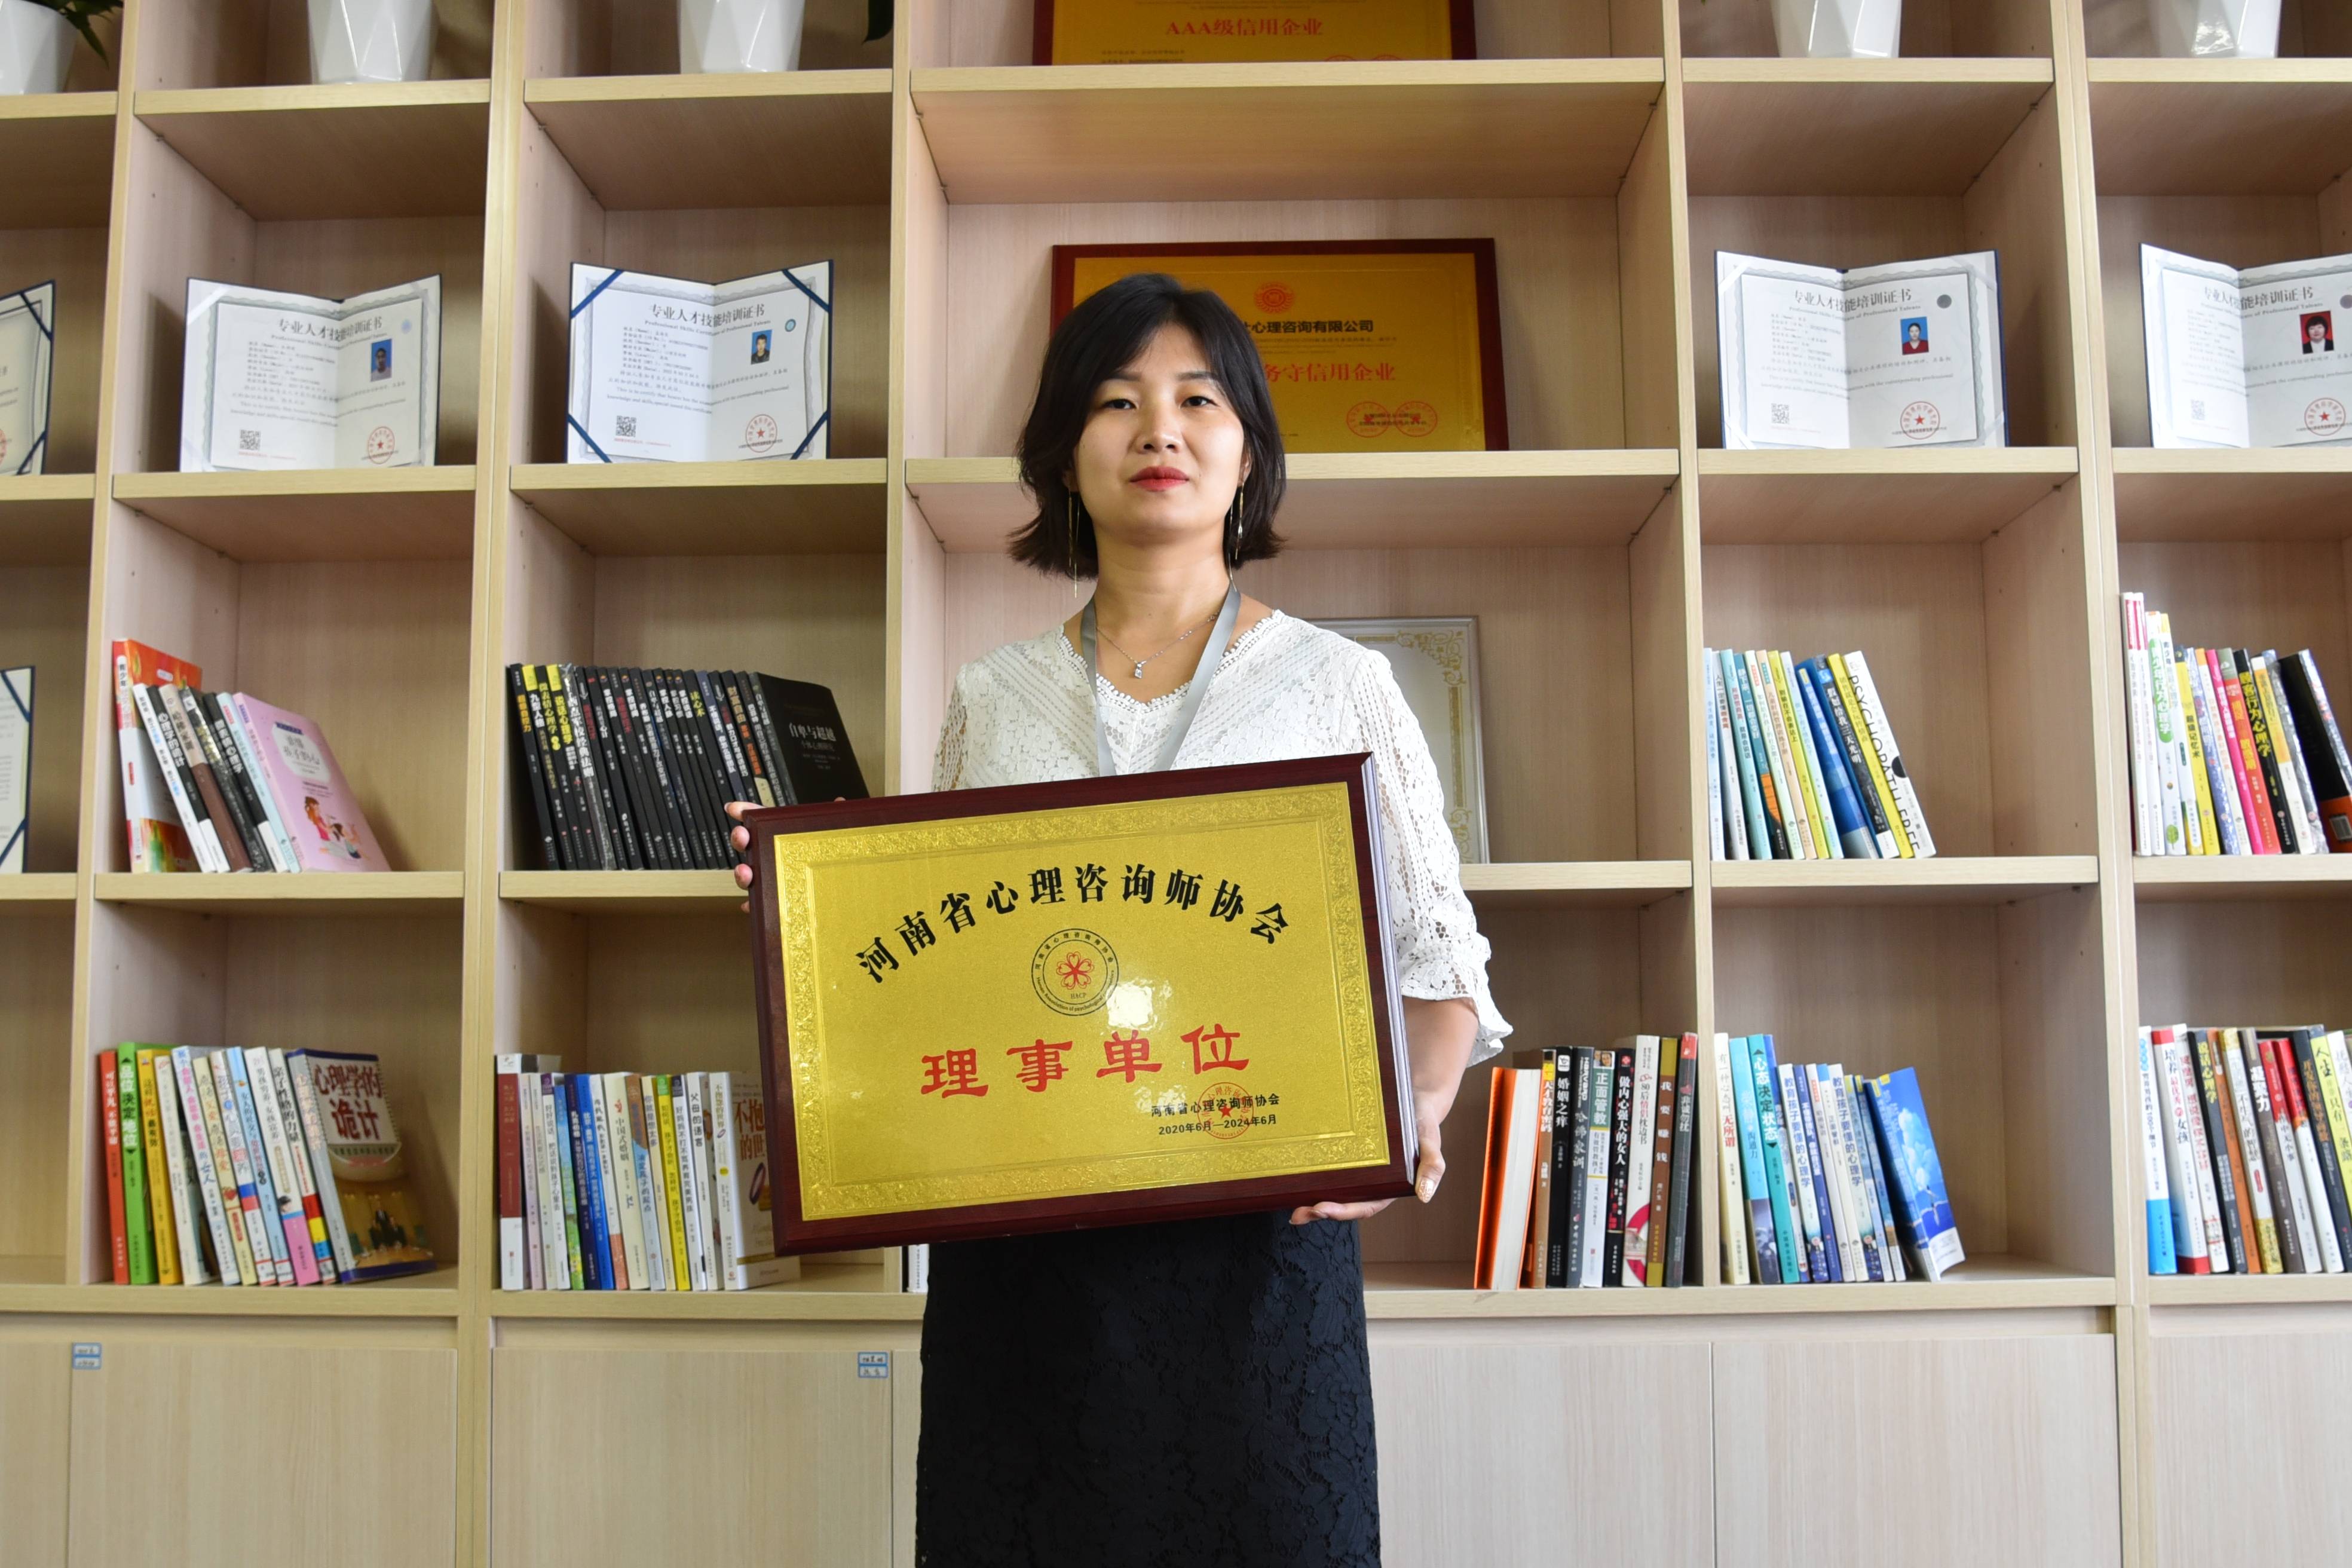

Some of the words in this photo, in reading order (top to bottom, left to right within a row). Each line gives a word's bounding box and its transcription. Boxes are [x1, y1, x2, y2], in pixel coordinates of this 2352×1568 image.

[1166, 18, 1324, 36] AAA级信用企业
[649, 304, 765, 327] 专业人才技能培训证书
[1794, 288, 1912, 313] 专业人才技能培训证书
[1264, 363, 1395, 382] 务守信用企业
[529, 693, 545, 728] 九型人格
[789, 721, 837, 742] 自卑与超越
[856, 862, 1291, 984] 河南省心理咨询师协会
[314, 1064, 382, 1099] 心理学的
[921, 1023, 1251, 1100] 理事单位
[329, 1098, 379, 1140] 诡计
[691, 1092, 703, 1147] 父母的语言
[1151, 1093, 1280, 1117] 河南省心理咨询师协会
[1555, 1077, 1570, 1128] 婚姻之痒
[1592, 1072, 1609, 1125] 正面管教
[1679, 1095, 1691, 1132] 非诚勿扰
[1753, 1056, 1778, 1141] 心态决定状态
[1158, 1114, 1276, 1135] 2020年6月—2024年6月
[1573, 1111, 1588, 1169] 哈佛家训
[1615, 1075, 1631, 1165] 做内心强大的女人
[1784, 1077, 1811, 1188] 教育孩子要懂的心理学
[1832, 1077, 1861, 1187] 教育孩子要懂的心理学
